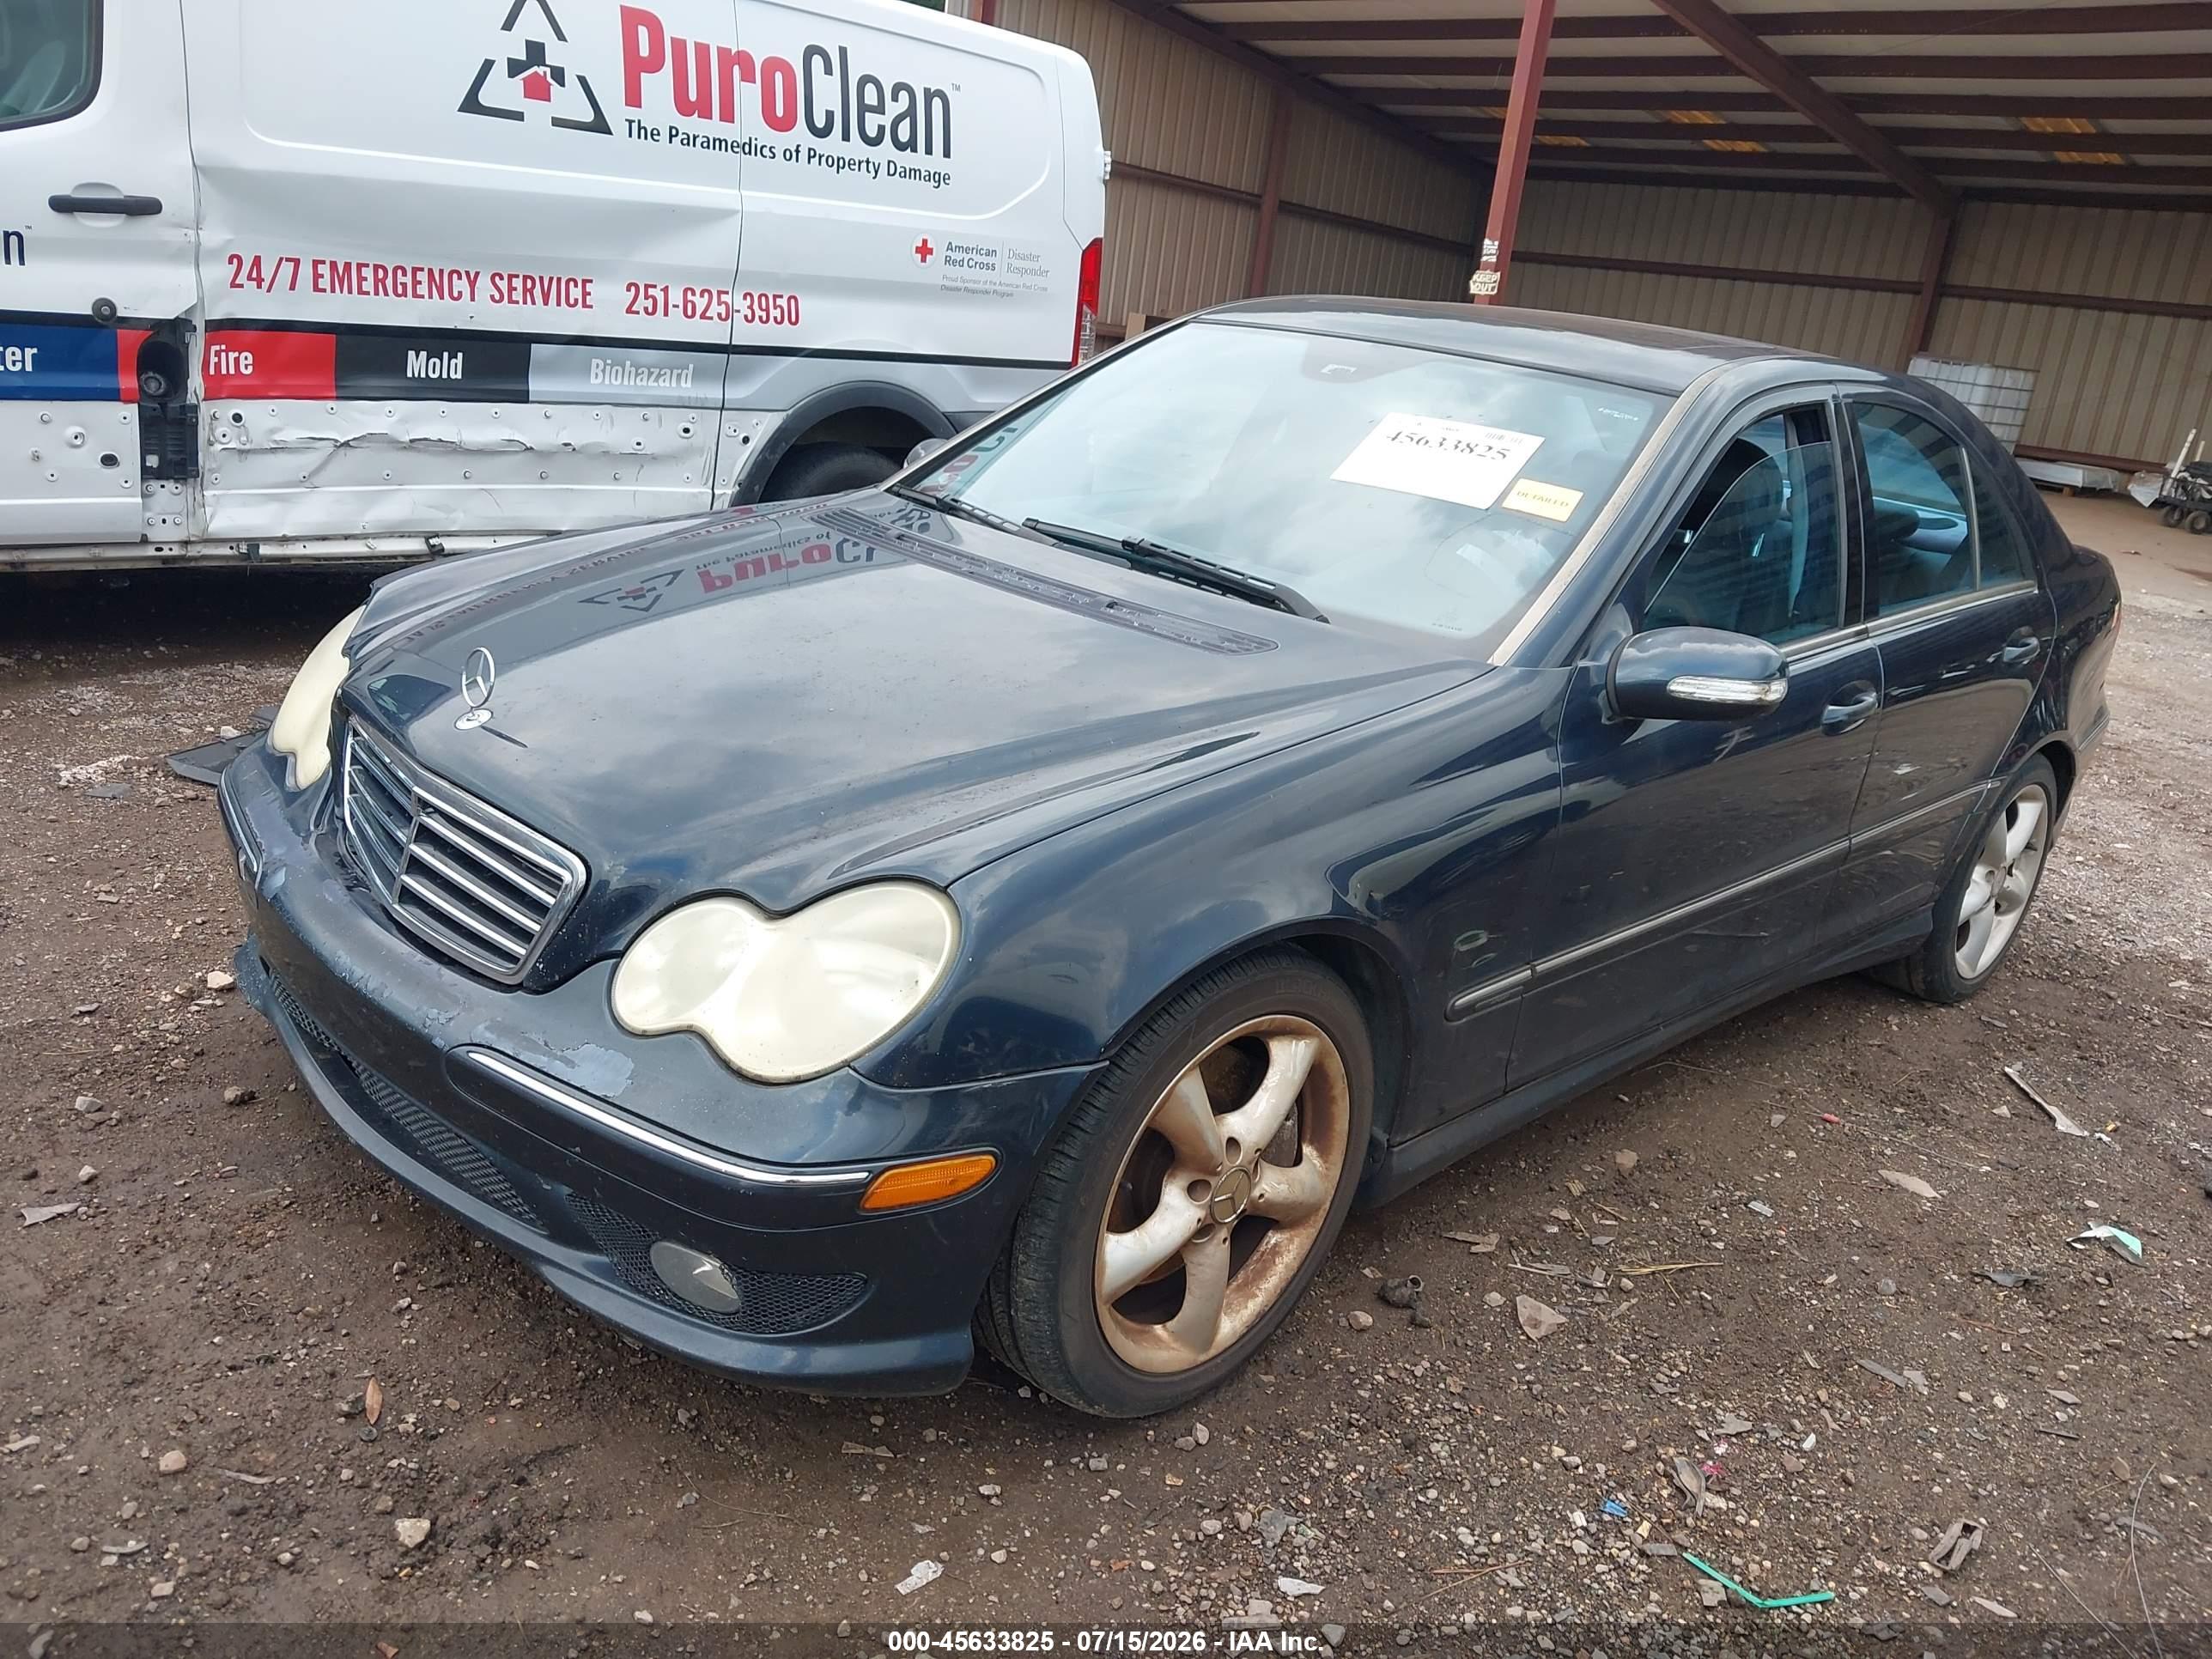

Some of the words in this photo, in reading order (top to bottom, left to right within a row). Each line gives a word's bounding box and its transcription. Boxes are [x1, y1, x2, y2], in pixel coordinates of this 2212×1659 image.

[625, 118, 661, 142] The
[669, 125, 776, 160] Paramedics
[782, 144, 802, 163] of
[807, 148, 881, 179] Property
[886, 160, 951, 188] Damage
[945, 241, 998, 258] American
[945, 255, 964, 268] Red
[967, 258, 996, 271] Cross
[1007, 248, 1040, 263] Disaster
[1006, 262, 1049, 278] Responder
[228, 253, 301, 294] 24/7
[312, 259, 480, 303] EMERGENCY
[489, 273, 594, 309] SERVICE
[624, 282, 800, 326] 251-625-3950
[209, 345, 254, 375] Fire
[406, 349, 464, 380] Mold
[590, 358, 694, 388] Biohazard
[1386, 430, 1511, 460] 45633825
